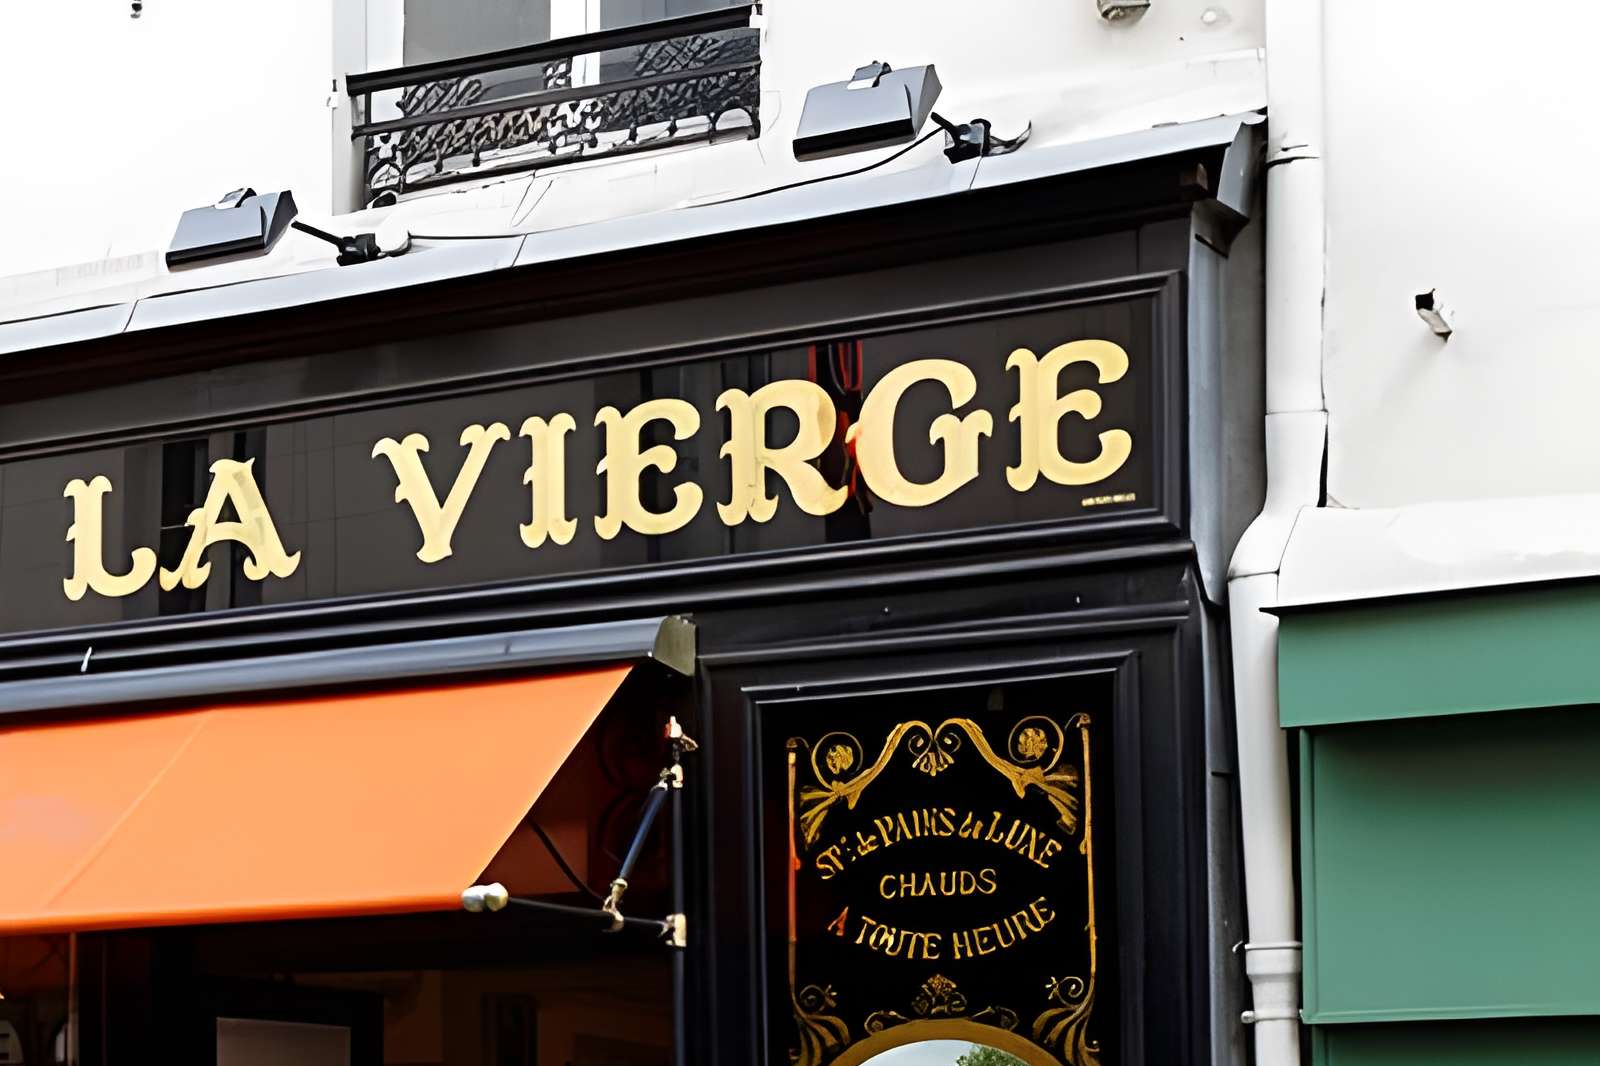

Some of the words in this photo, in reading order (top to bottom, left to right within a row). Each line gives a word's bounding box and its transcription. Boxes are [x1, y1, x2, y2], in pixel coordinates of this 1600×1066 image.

[63, 457, 301, 601] LA
[371, 339, 1133, 564] VIERGE
[985, 811, 1063, 868] LUXE
[880, 868, 997, 899] CHAUDS
[855, 915, 942, 960] TOUTE
[952, 897, 1056, 960] HEURE
